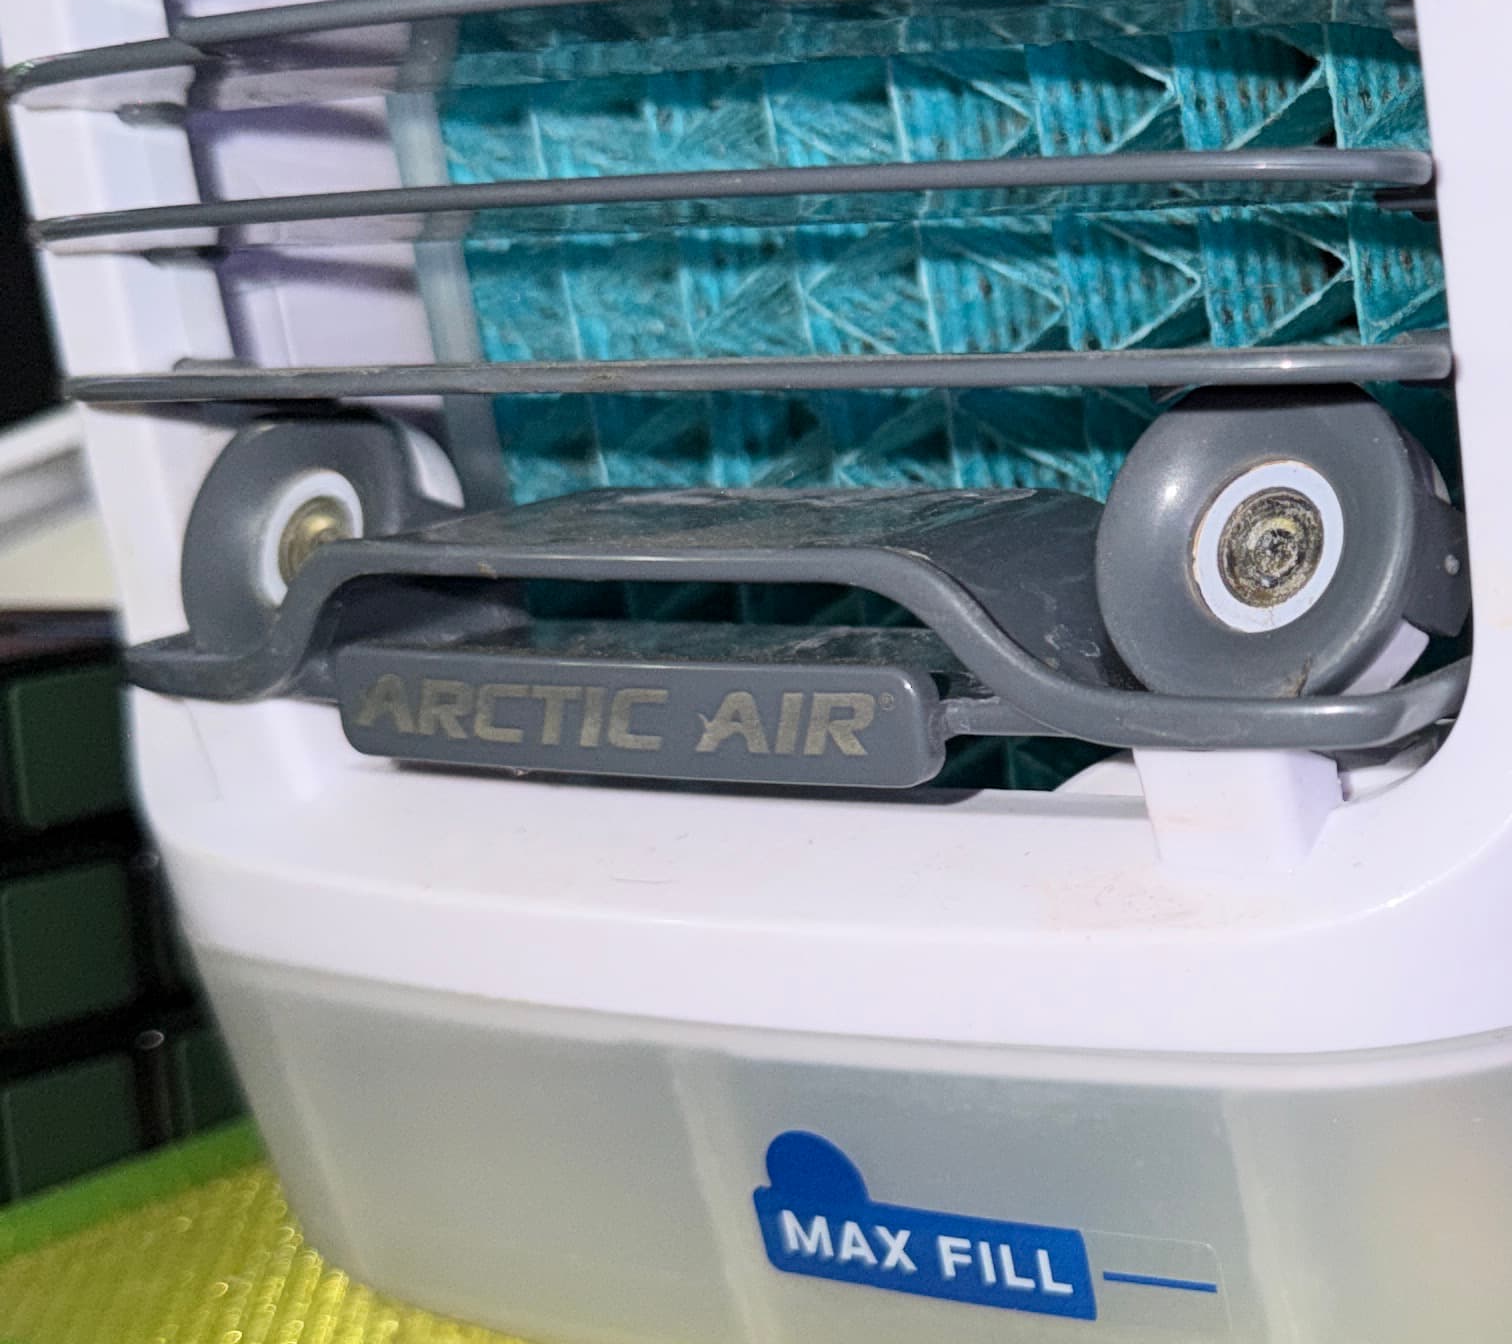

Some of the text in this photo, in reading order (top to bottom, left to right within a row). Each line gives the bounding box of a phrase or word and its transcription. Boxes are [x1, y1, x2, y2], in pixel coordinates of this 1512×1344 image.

[355, 672, 669, 751] ARCTIC
[780, 1208, 1074, 1295] MAX FILL
